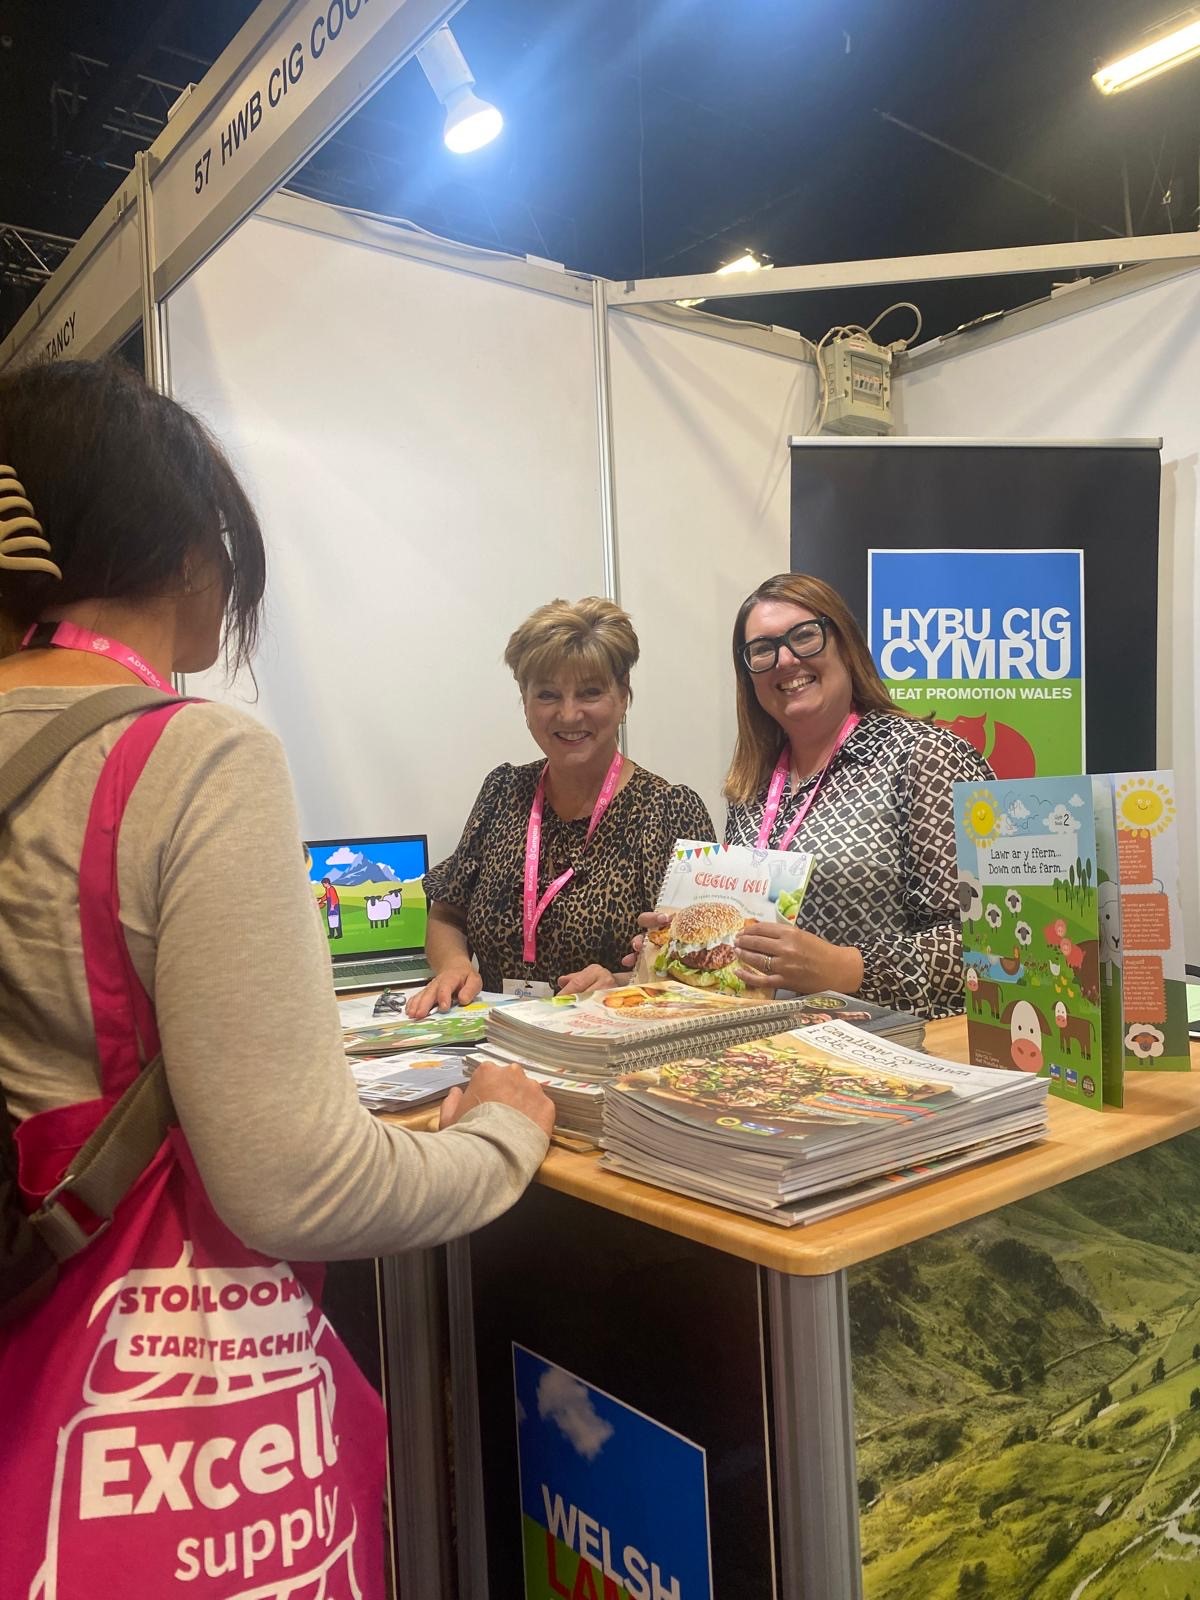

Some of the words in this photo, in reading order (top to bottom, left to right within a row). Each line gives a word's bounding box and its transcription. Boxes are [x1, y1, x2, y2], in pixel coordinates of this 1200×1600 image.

[194, 148, 212, 194] 57
[221, 90, 262, 166] HWB
[268, 42, 304, 108] CIG
[310, 0, 368, 59] CO
[40, 311, 76, 363] TANCY
[882, 607, 991, 641] HYBU
[1002, 607, 1071, 641] CIG
[880, 638, 1071, 680] CYMRU
[926, 687, 1016, 700] PROMOTION
[1019, 687, 1072, 700] WALES
[1063, 813, 1070, 827] 2
[988, 863, 1010, 875] Down
[1011, 866, 1022, 875] on
[1023, 862, 1037, 874] the
[990, 848, 1010, 860] Lawr
[1012, 850, 1021, 860] ar
[1023, 850, 1030, 861] y
[694, 871, 739, 890] CEGIN
[822, 1024, 892, 1057] Canllaw
[893, 1054, 972, 1077] cyflawn
[174, 1484, 339, 1582] supply
[541, 1483, 681, 1600] WELSH
